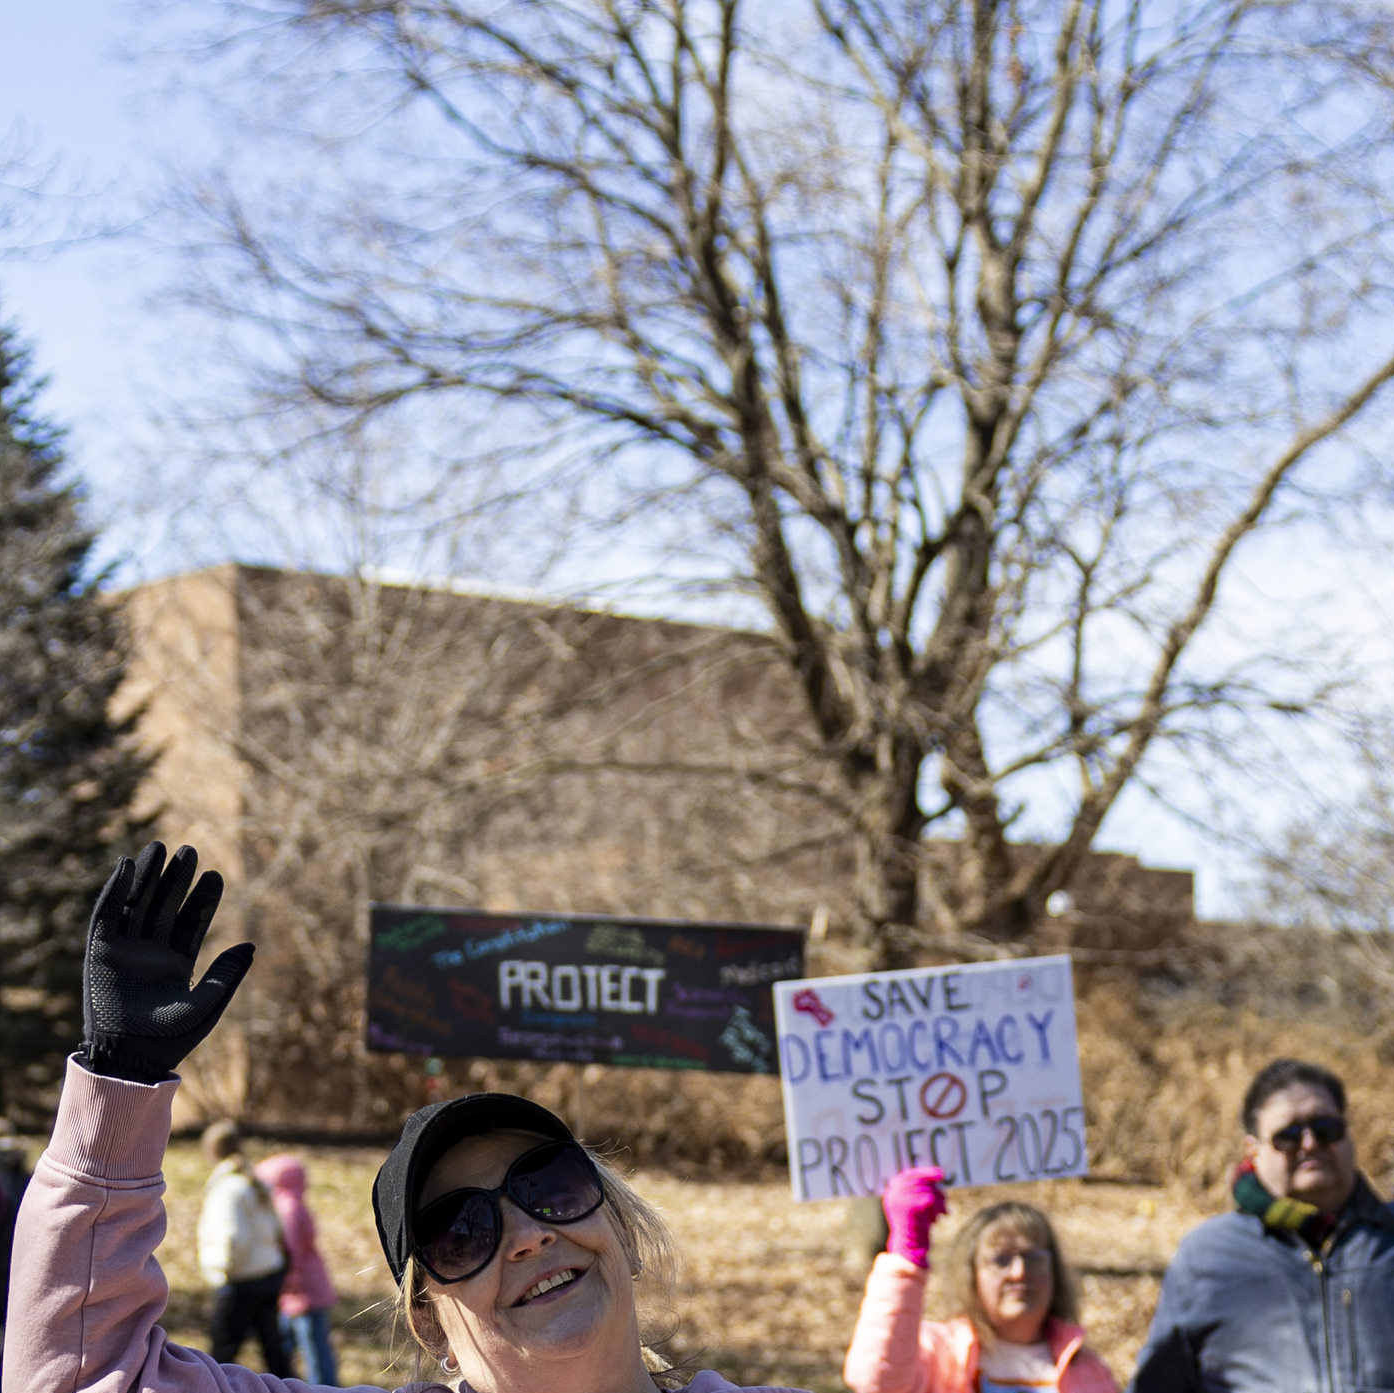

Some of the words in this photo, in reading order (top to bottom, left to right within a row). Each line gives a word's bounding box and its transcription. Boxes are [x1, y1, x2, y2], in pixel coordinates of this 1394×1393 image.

[497, 959, 667, 1015] PROTECT
[862, 971, 972, 1021] SAVE
[781, 1009, 1054, 1085] DEMOCRACY
[798, 1120, 976, 1199] PROJECT
[993, 1106, 1085, 1182] 2025
